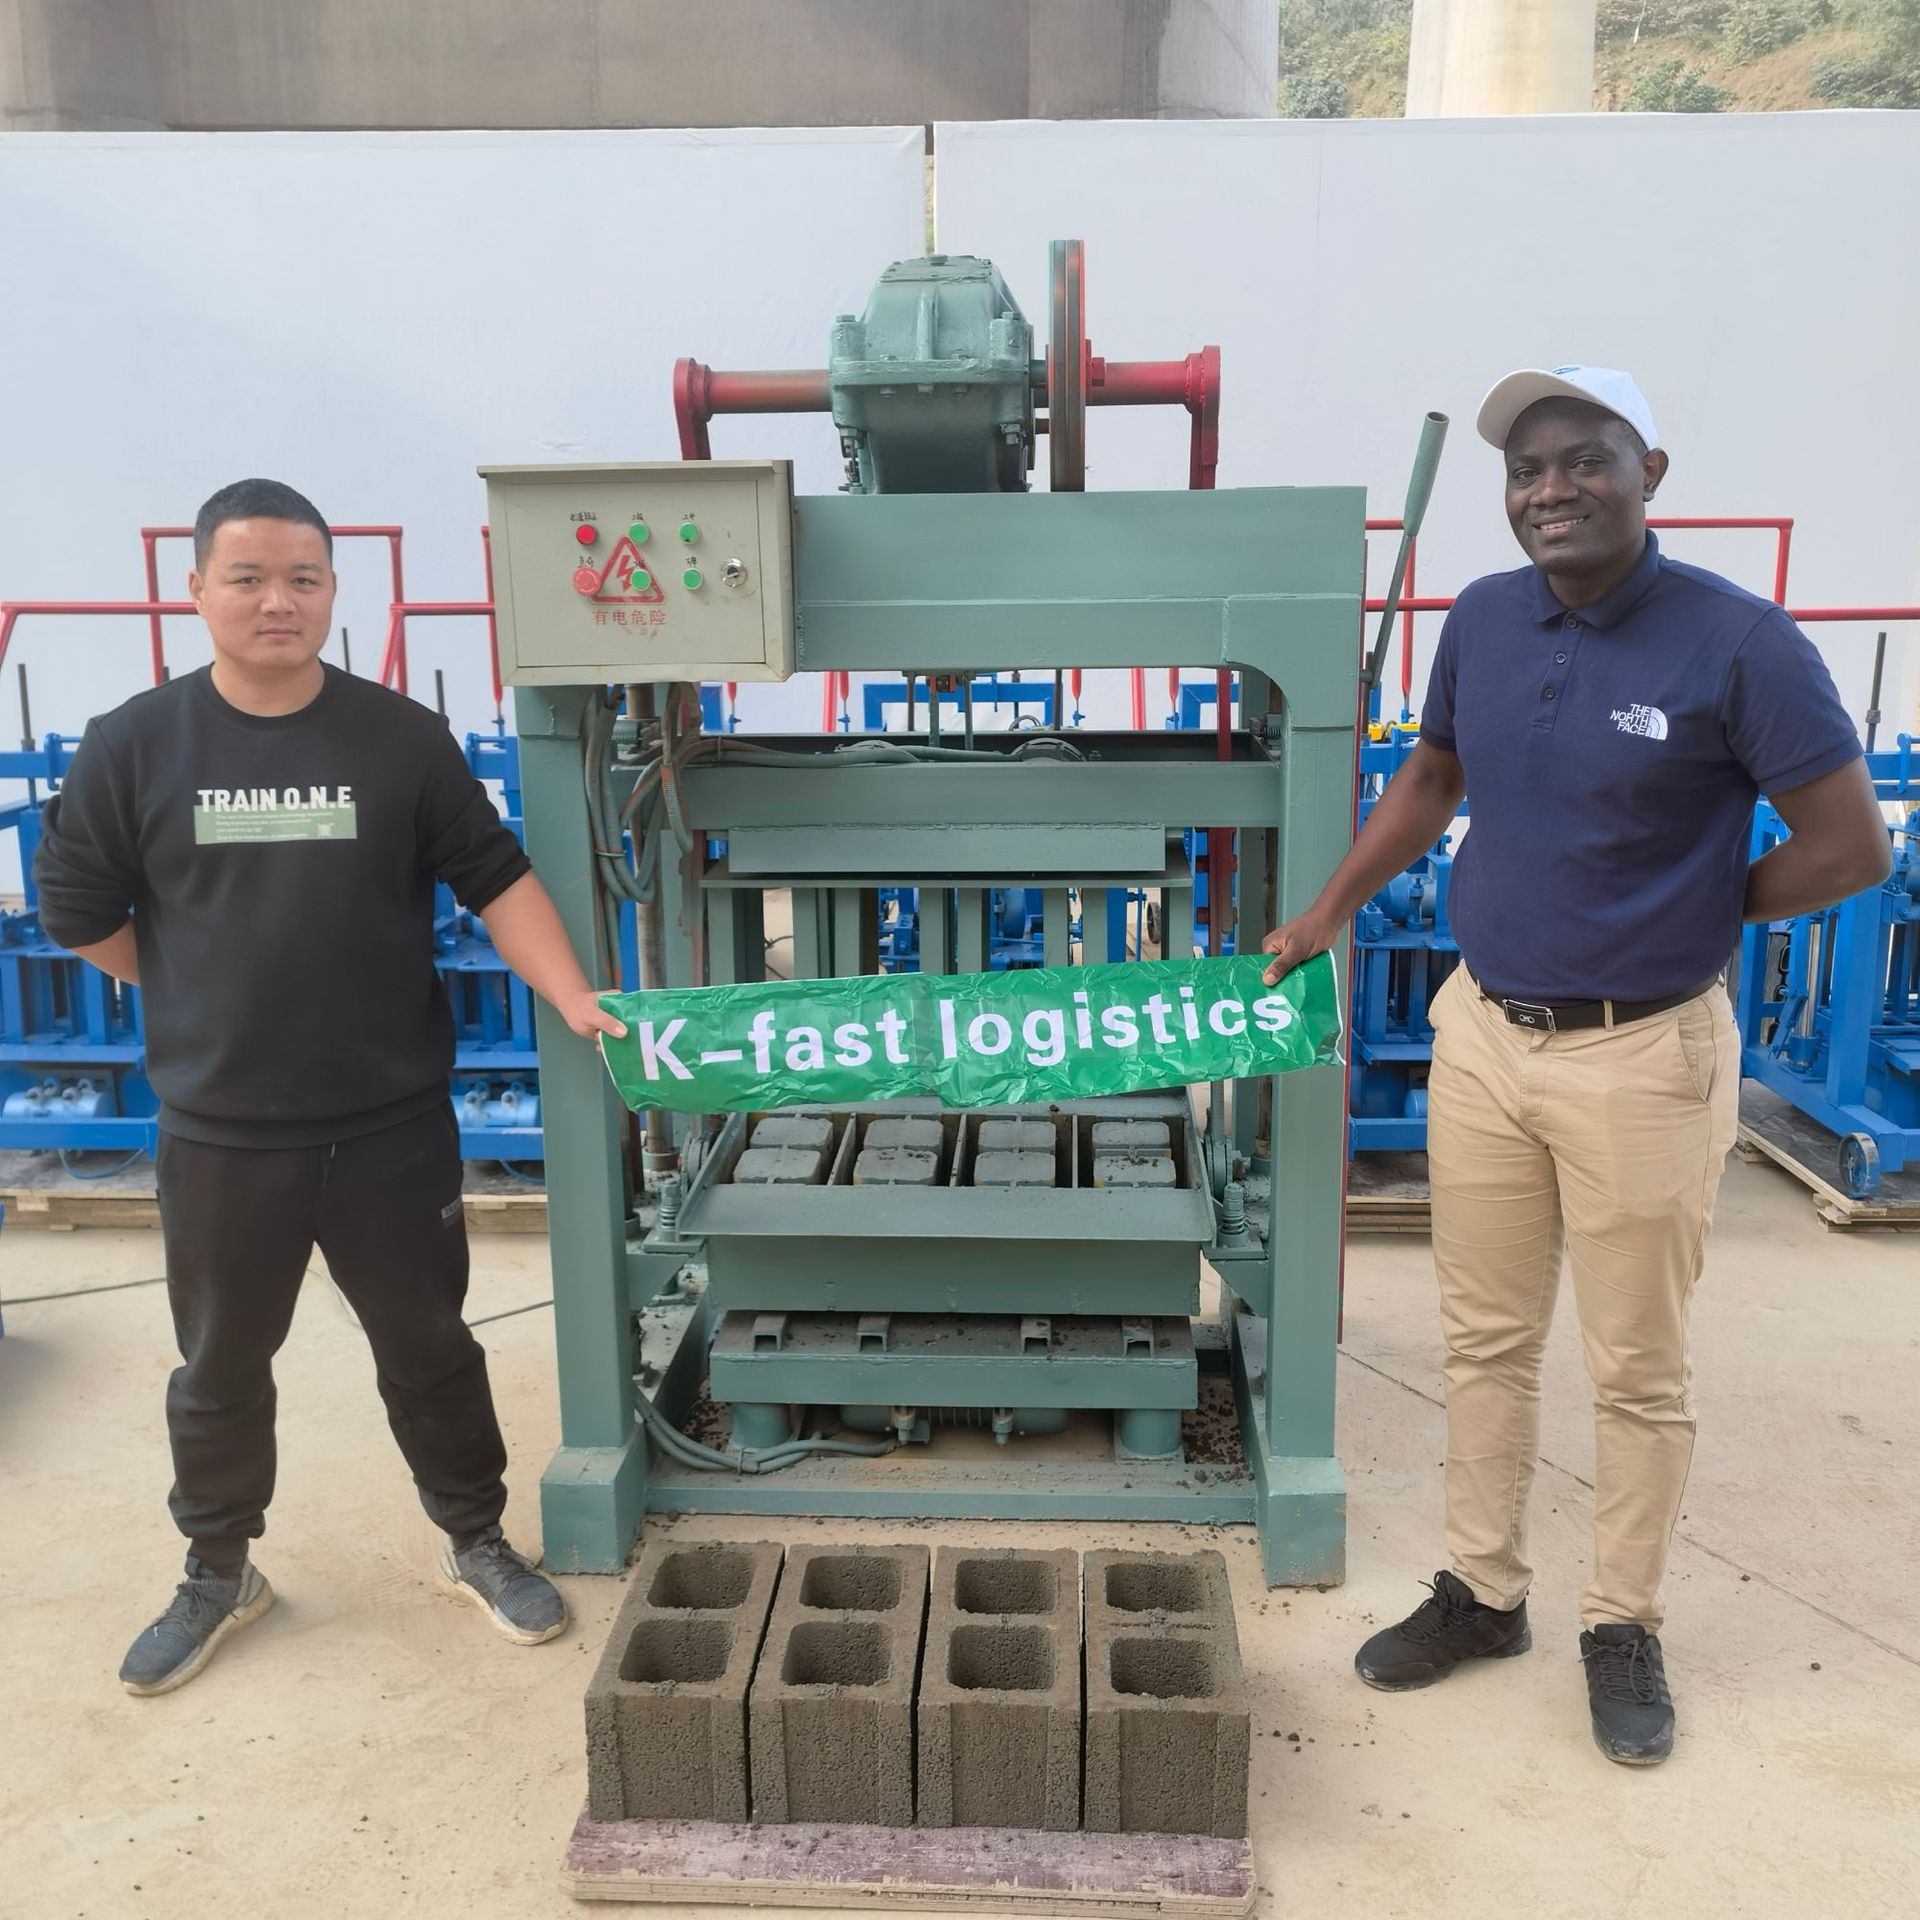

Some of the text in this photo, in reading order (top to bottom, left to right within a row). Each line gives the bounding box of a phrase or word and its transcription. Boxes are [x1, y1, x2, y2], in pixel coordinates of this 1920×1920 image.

[592, 609, 667, 626] 有电危险
[1610, 709, 1649, 727] NORTH
[1630, 703, 1651, 716] THE
[1617, 721, 1647, 736] FACE
[197, 785, 352, 813] TRAIN O.N.E
[939, 986, 1295, 1067] logistics
